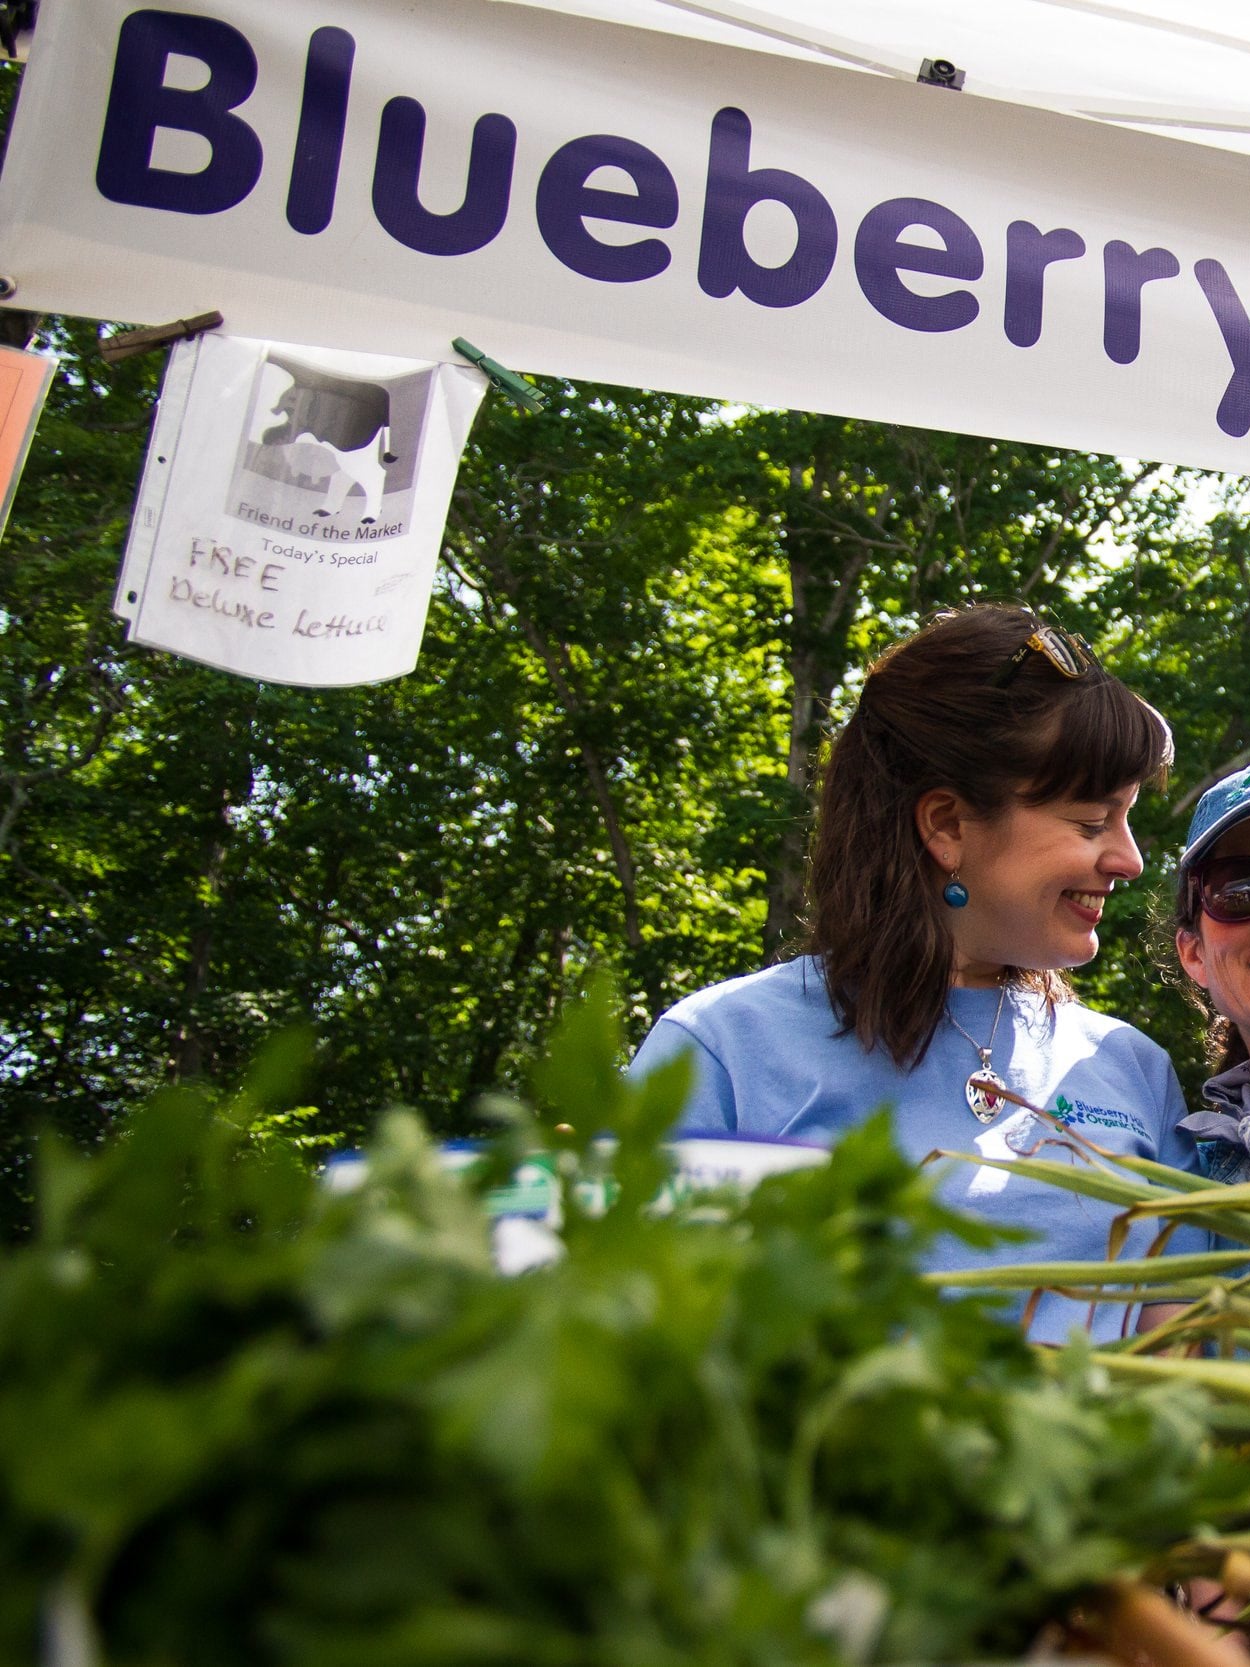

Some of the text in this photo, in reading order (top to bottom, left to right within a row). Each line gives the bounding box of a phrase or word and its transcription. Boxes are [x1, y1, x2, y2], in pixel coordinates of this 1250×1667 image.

[237, 502, 403, 541] Friend of the Market
[189, 537, 287, 592] FREE
[261, 537, 378, 568] Today's Special
[168, 575, 275, 629] Deluxe
[1074, 1099, 1128, 1122] Blueberry
[1086, 1113, 1131, 1130] Organic
